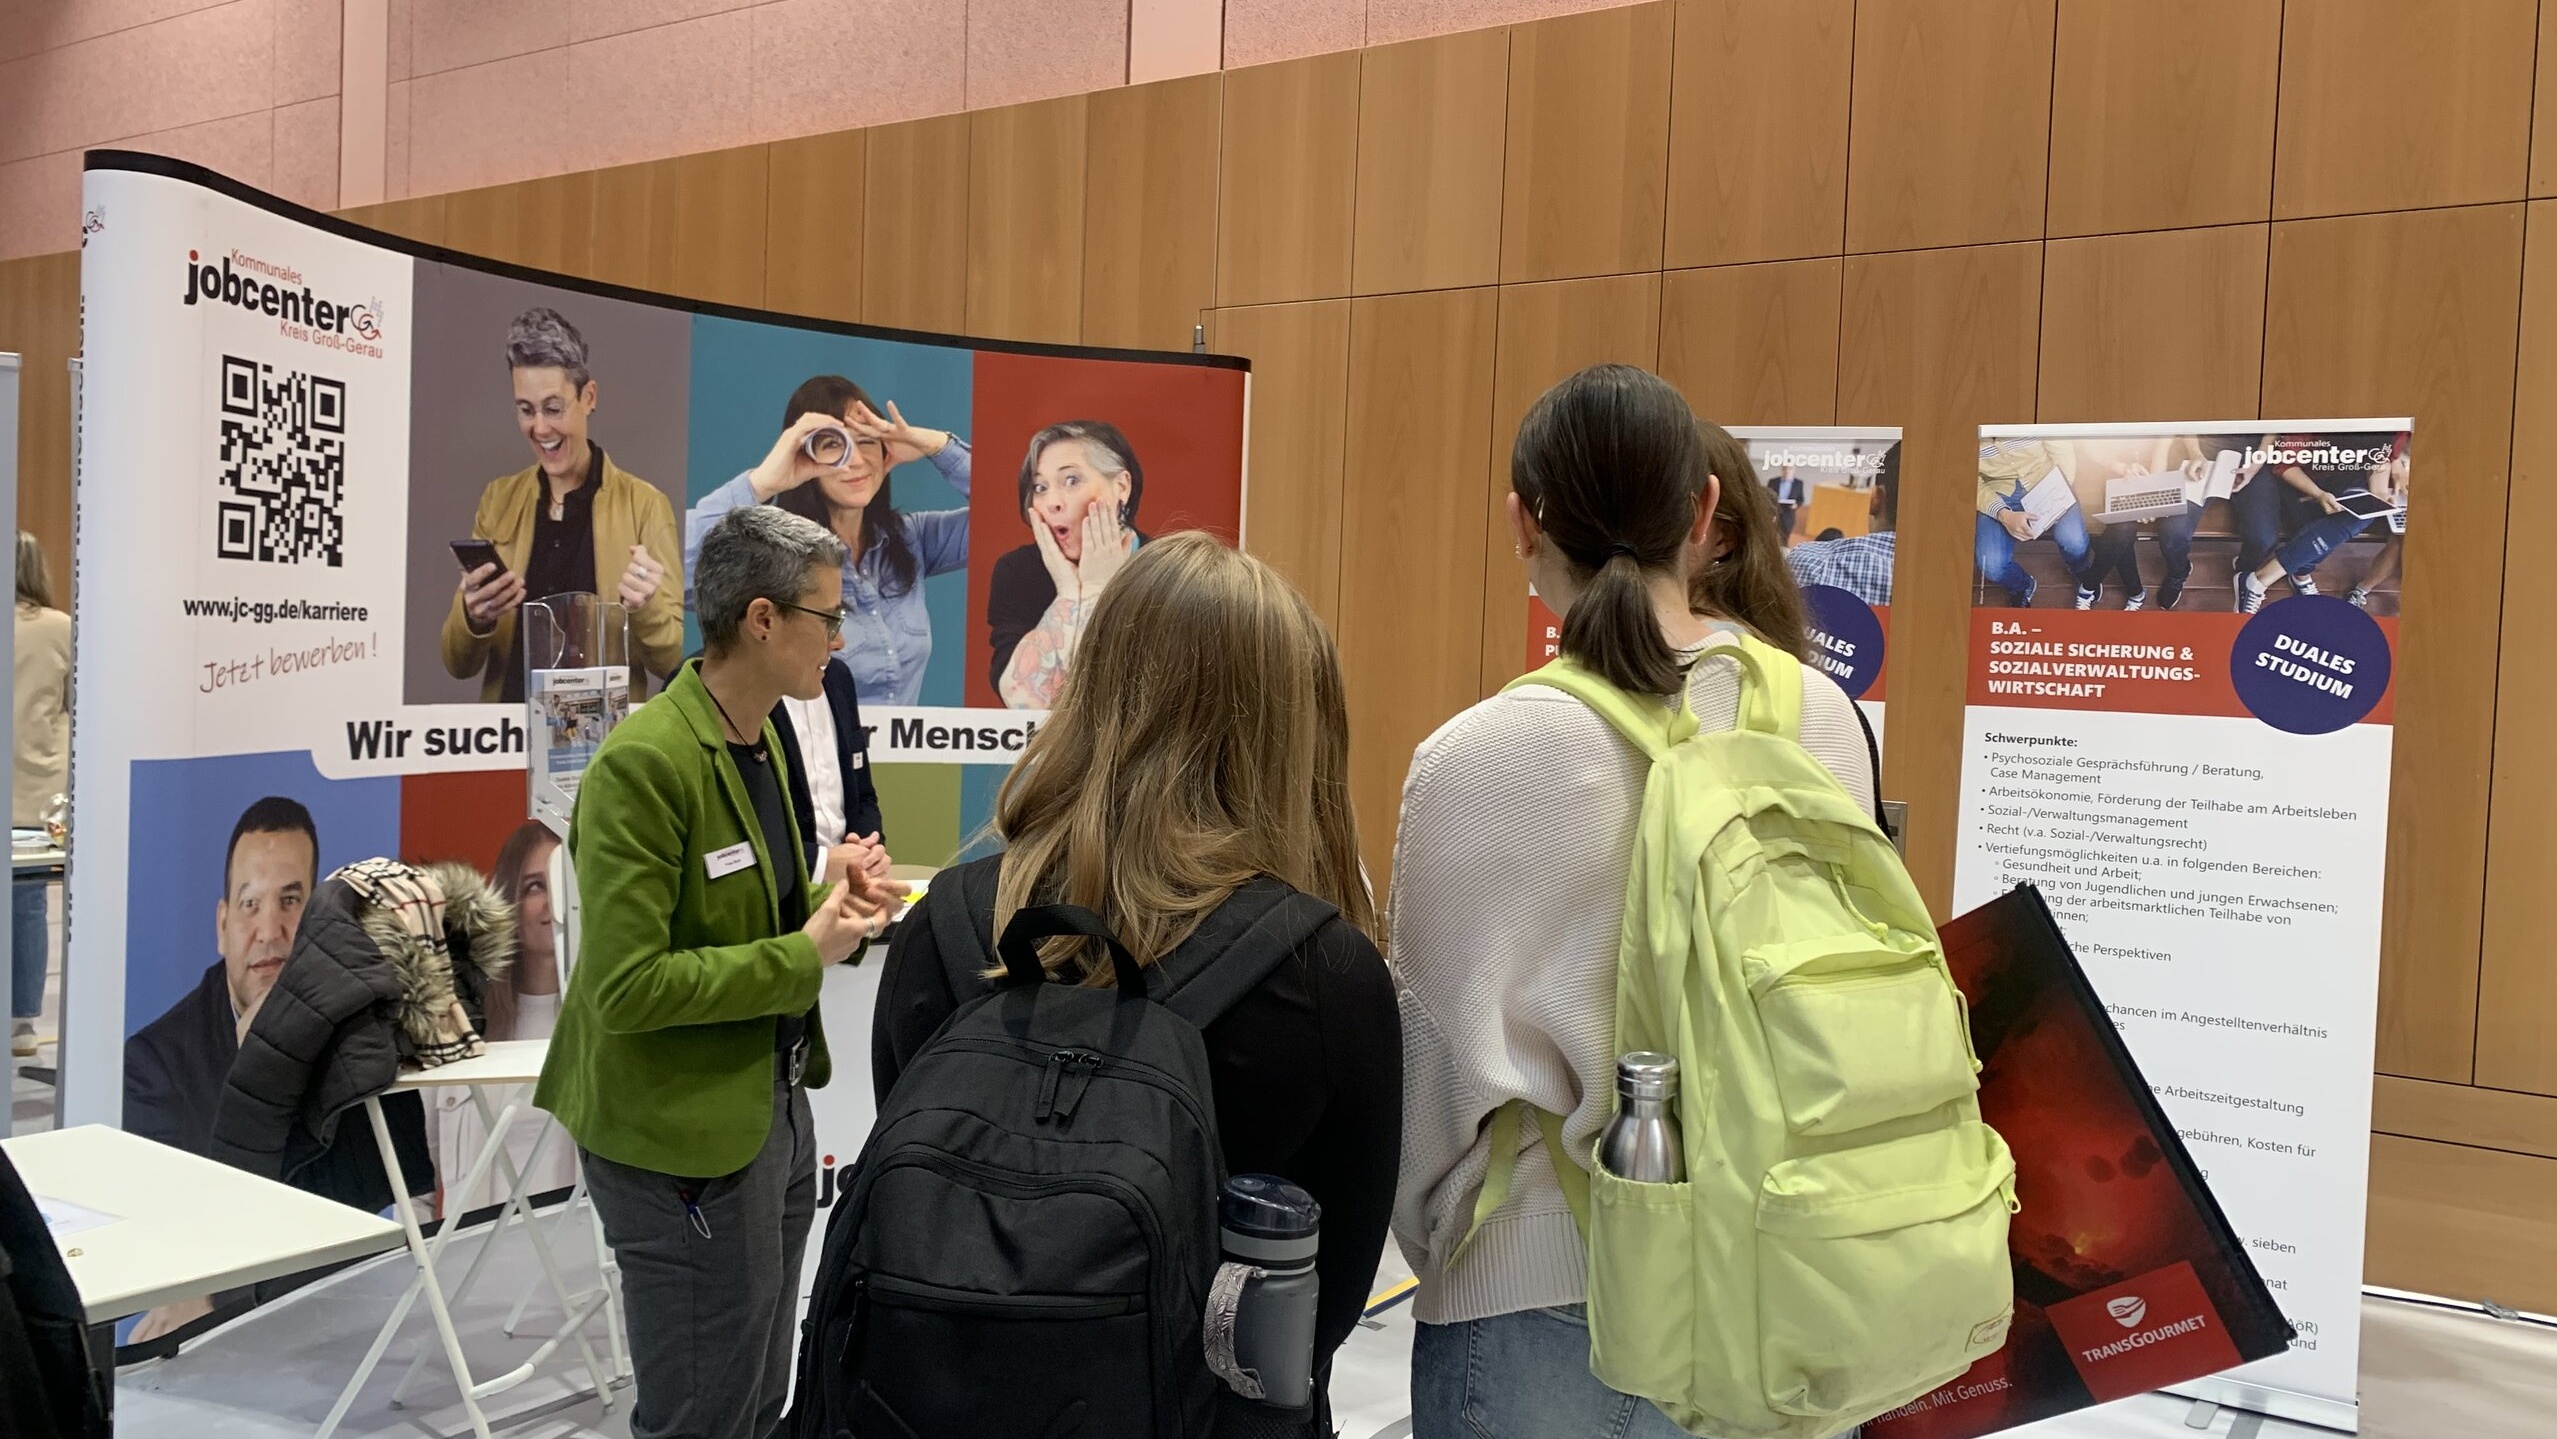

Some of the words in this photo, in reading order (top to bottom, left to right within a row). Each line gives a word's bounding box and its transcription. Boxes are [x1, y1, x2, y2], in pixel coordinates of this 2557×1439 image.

[231, 248, 303, 285] Kommunales
[184, 249, 350, 334] jobcenter
[280, 320, 309, 342] Kreis
[313, 329, 383, 359] Groß-Gerau
[2242, 445, 2368, 470] jobcenter
[2274, 440, 2331, 448] Kommunales
[1762, 449, 1866, 470] jobcenter
[2312, 463, 2335, 471] Kreis
[183, 596, 368, 623] www.jc-gg.de/karriere
[1803, 626, 1856, 657] UALES
[1992, 621, 2027, 636] B.A.
[200, 654, 264, 693] Jetzt
[270, 636, 366, 675] bewerben
[1990, 641, 2063, 657] SOZIALE
[2068, 643, 2175, 660] SICHERUNG
[2180, 647, 2194, 661] &
[2274, 633, 2356, 675] DUALES
[1989, 661, 2201, 681] SOZIALVERWALTUNGS-
[2255, 652, 2354, 699] STUDIUM
[1988, 680, 2106, 698] WIRTSCHAFT
[347, 720, 412, 760] Wir
[424, 717, 524, 757] such
[1985, 732, 2078, 748] Schwerpunkte:
[1990, 767, 2018, 778] Case
[2021, 769, 2102, 784] Management
[1992, 752, 2073, 767] Psychosoziale
[2076, 757, 2189, 776] Gesprächsführung
[2202, 764, 2264, 781] Beratung,
[1988, 804, 2188, 829] Sozial-/Verwaltungsmanagement
[1989, 786, 2094, 804] Arbeitsökonomie,
[2098, 792, 2162, 810] Förderung
[2165, 797, 2187, 809] der
[2191, 799, 2244, 813] Teilhabe
[2247, 805, 2268, 815] am
[2271, 804, 2357, 821] Arbeitsleben
[1987, 823, 2019, 836] Recht
[2023, 826, 2046, 839] (v.a.
[2050, 827, 2208, 852] Sozial-/Verwaltungsrecht)
[1986, 842, 2138, 865] Vertiefungsmöglichkeiten
[2142, 857, 2163, 867] u.a.
[2167, 856, 2179, 867] in
[2183, 857, 2248, 873] folgenden
[2252, 863, 2322, 879] Bereichen:
[2002, 858, 2071, 874] Gesundheit
[2074, 865, 2098, 877] und
[2101, 867, 2142, 881] Arbeit;
[2002, 874, 2056, 890] Beratung
[2060, 880, 2081, 890] von
[2085, 880, 2166, 898] Jugendlichen
[2170, 890, 2195, 900] und
[2196, 890, 2244, 906] jungen
[2249, 895, 2339, 915] Erwachsenen;
[2067, 895, 2088, 906] der
[2090, 897, 2205, 917] arbeitsmarktlichen
[2209, 907, 2263, 922] Teilhabe
[2267, 915, 2291, 925] von
[2094, 943, 2172, 962] Perspektiven
[2161, 1008, 2177, 1021] im
[2180, 1011, 2328, 1039] Angestelltenverhältnis
[2164, 1085, 2304, 1117] Arbeitszeitgestaltung
[2176, 1128, 2243, 1148] gebühren,
[2247, 1137, 2293, 1154] Kosten
[2297, 1144, 2316, 1157] für
[2252, 1237, 2296, 1254] sieben
[1932, 1391, 1957, 1408] Mit
[1957, 1376, 2013, 1400] Genuss.
